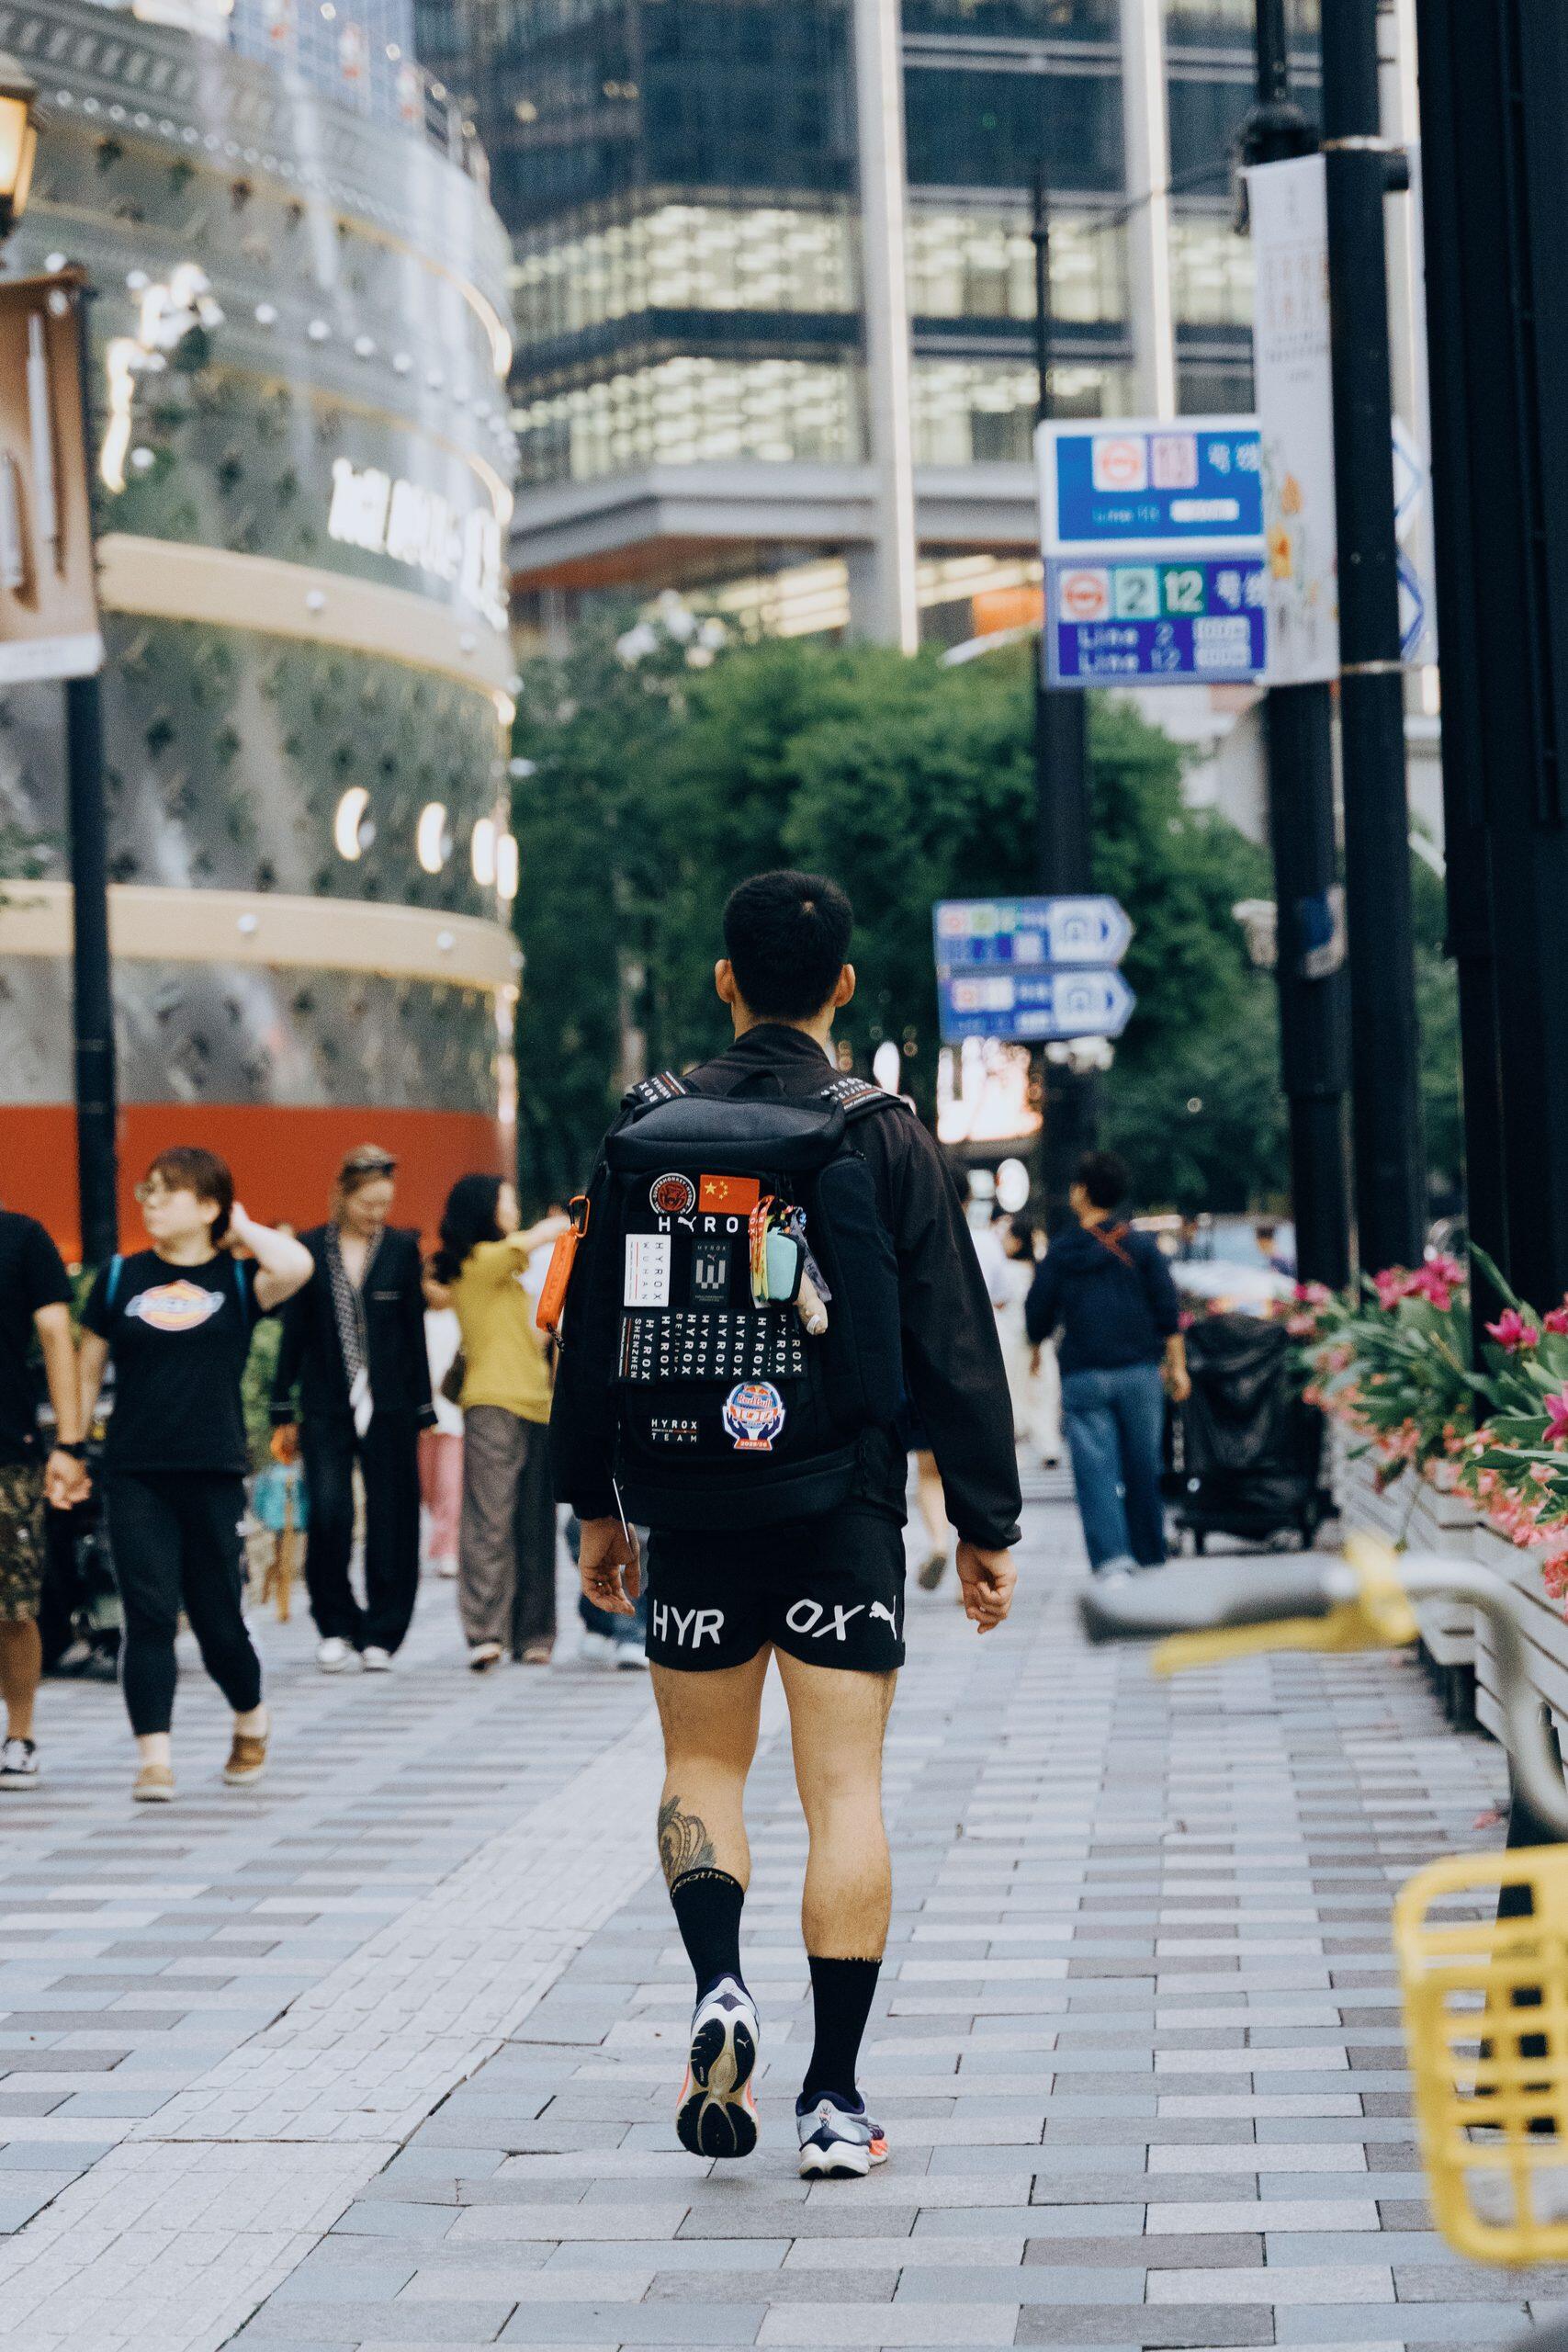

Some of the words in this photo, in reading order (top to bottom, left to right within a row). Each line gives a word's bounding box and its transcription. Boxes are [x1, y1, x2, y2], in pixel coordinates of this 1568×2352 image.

[1123, 575, 1147, 612] 2
[1165, 569, 1203, 612] 12
[1155, 622, 1175, 646] 2
[638, 1081, 659, 1102] ROX
[658, 1216, 750, 1233] HYRO
[653, 1242, 664, 1300] HYROX
[630, 1317, 642, 1379] SHENZHEN
[641, 1319, 655, 1380] HYROX
[660, 1316, 671, 1376] HYROX
[681, 1314, 696, 1374] HYROX
[695, 1315, 710, 1375] HYROX
[715, 1314, 728, 1375] HYROX
[732, 1315, 746, 1376] HYROX
[751, 1317, 767, 1376] HYROX
[792, 1339, 802, 1373] ROX
[738, 1394, 754, 1405] Red
[651, 1419, 697, 1430] HYROX
[651, 1432, 697, 1442] TEAM
[652, 1599, 725, 1649] HYR
[785, 1598, 865, 1641] OX
